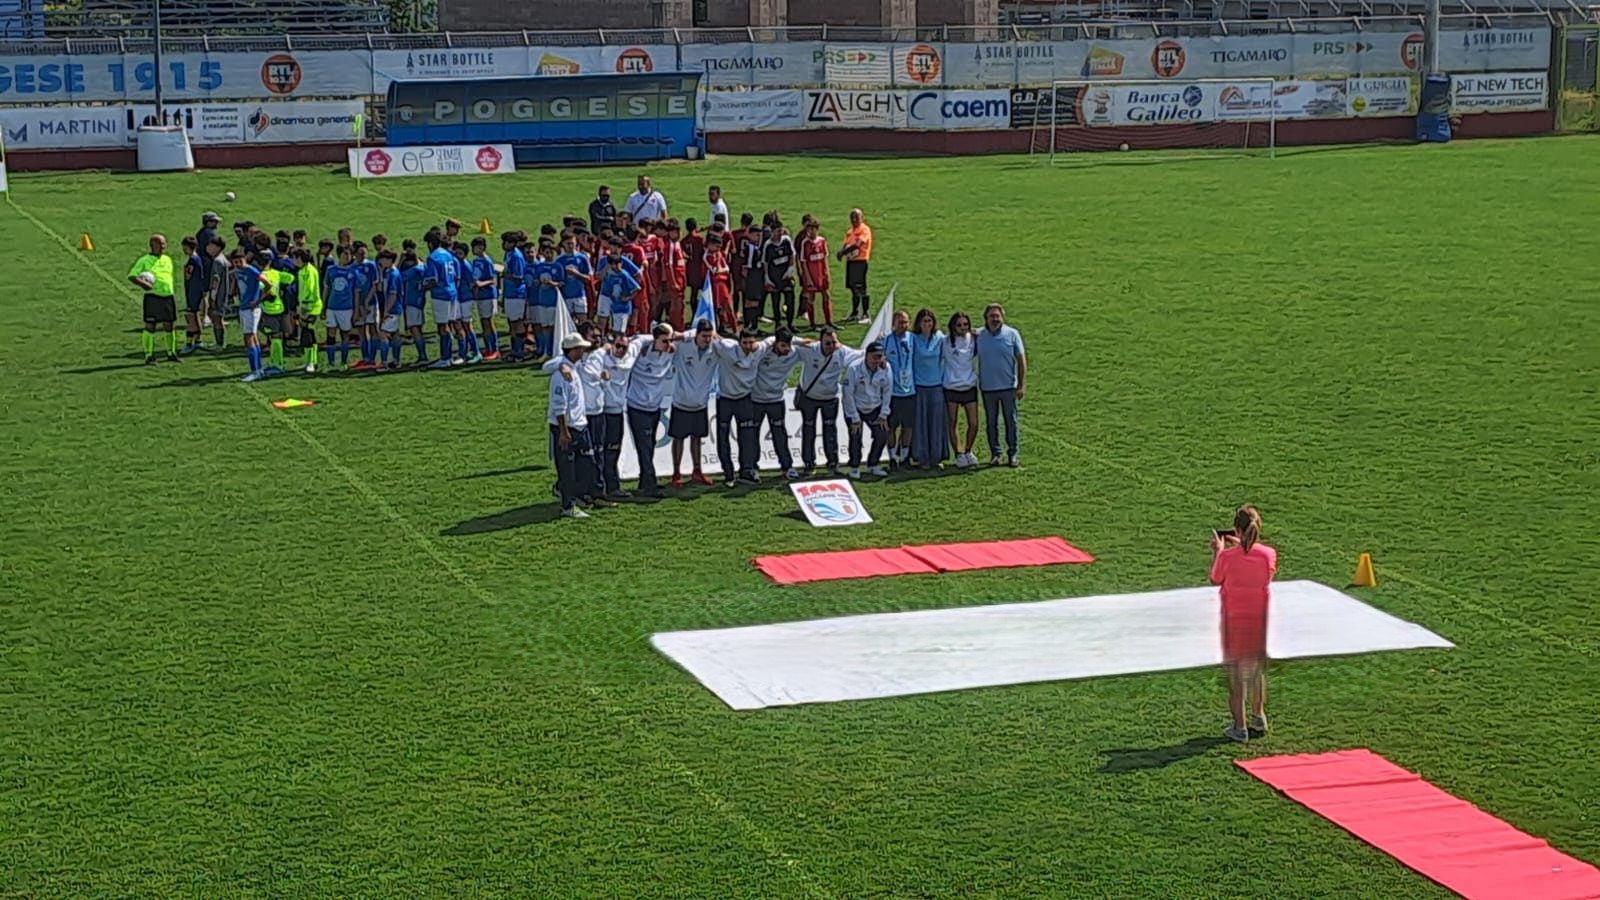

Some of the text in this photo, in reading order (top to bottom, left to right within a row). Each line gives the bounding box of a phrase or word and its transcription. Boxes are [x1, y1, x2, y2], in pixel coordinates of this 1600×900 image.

[1313, 42, 1345, 55] PRS
[419, 52, 494, 66] STAR BOTTLE
[1210, 49, 1287, 63] TIGAMARO
[701, 56, 784, 71] TIGAMARO
[108, 61, 223, 93] 1915
[1477, 80, 1507, 92] NEW
[1510, 78, 1543, 91] TECH
[1127, 91, 1180, 104] Banca
[434, 95, 688, 120] POGGESE
[940, 99, 1008, 118] caem
[1126, 105, 1203, 121] Galileo
[39, 119, 116, 135] MARTINI
[317, 114, 357, 127] general
